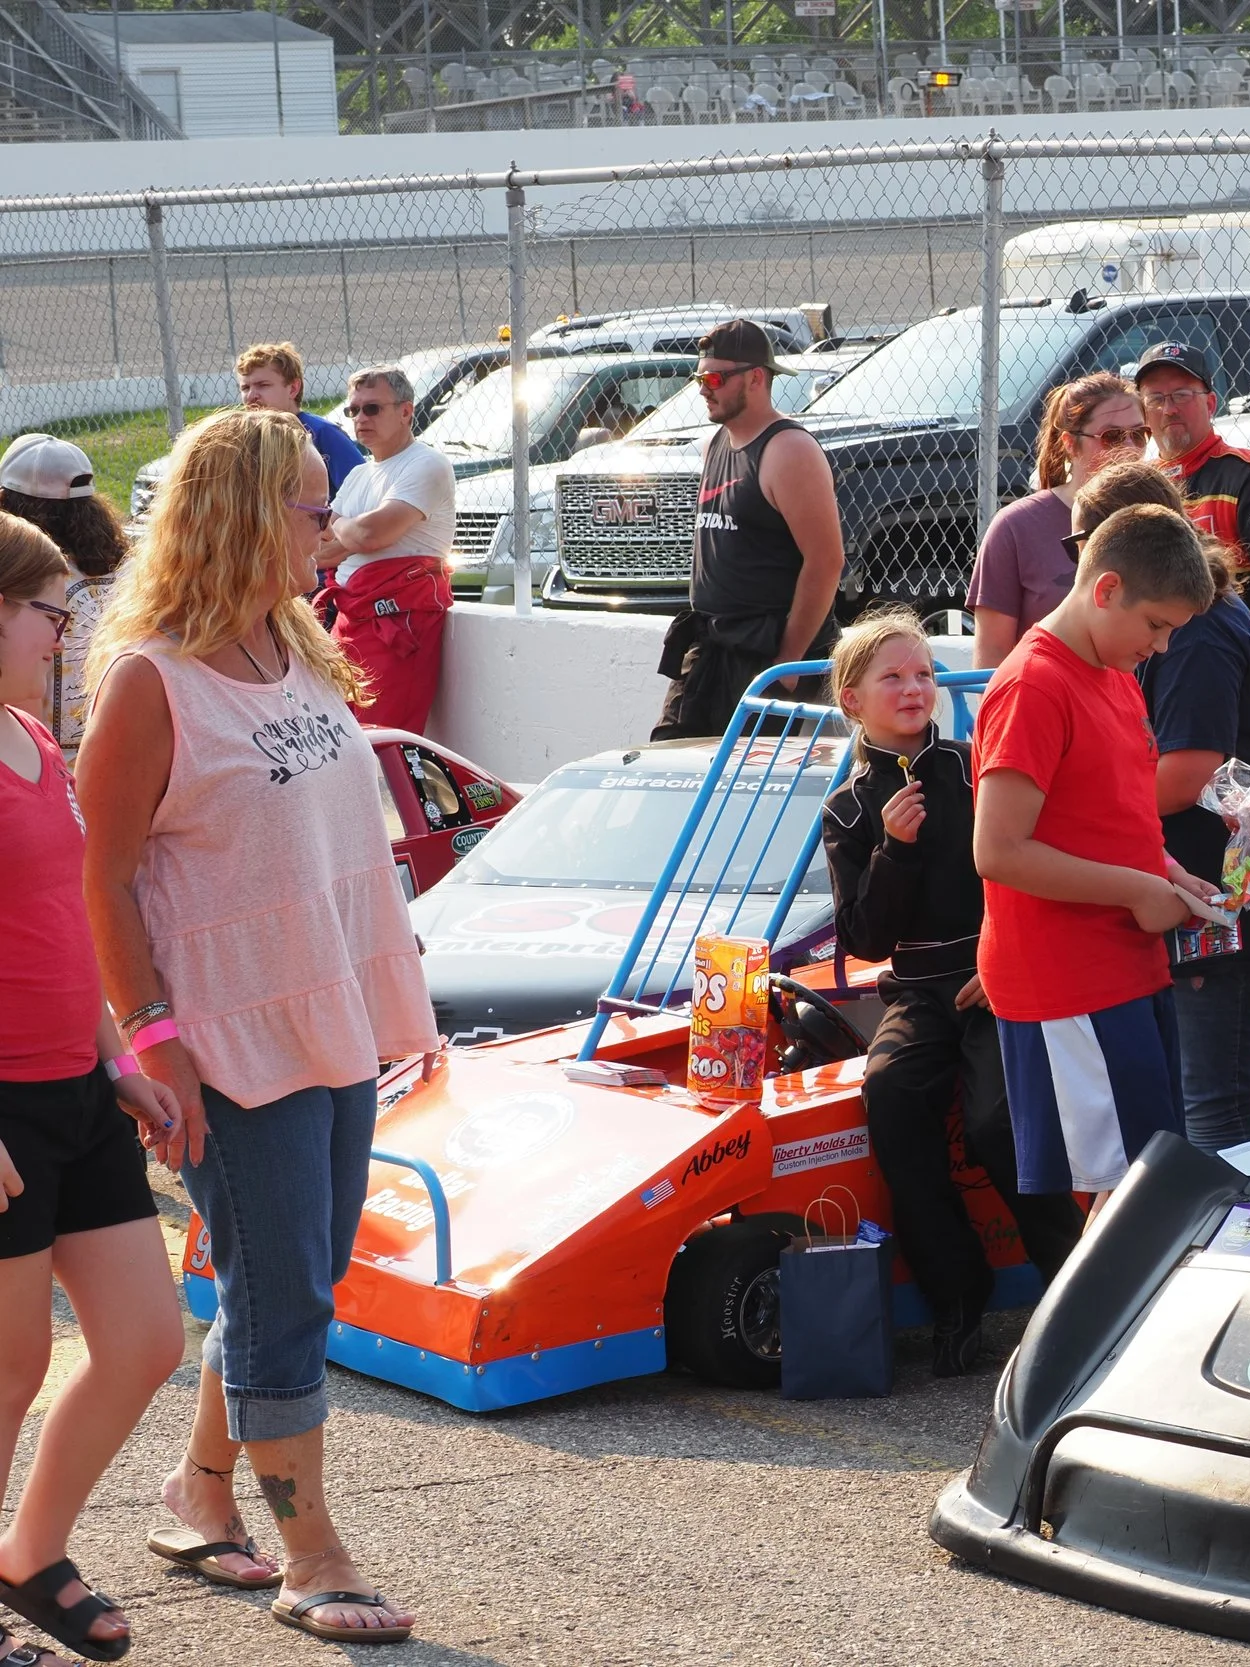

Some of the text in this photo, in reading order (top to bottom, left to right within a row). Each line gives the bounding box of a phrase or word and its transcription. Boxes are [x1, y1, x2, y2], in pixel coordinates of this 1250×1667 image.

[592, 499, 653, 523] GMC
[263, 715, 308, 740] BLESSED
[252, 717, 352, 765] Grandma
[473, 796, 496, 811] FARMS
[812, 1136, 846, 1153] Molds
[848, 1132, 869, 1146] Inc.
[681, 1129, 751, 1186] Abbey
[777, 1147, 864, 1172] Custom Injection Molds
[364, 1188, 435, 1232] Racing
